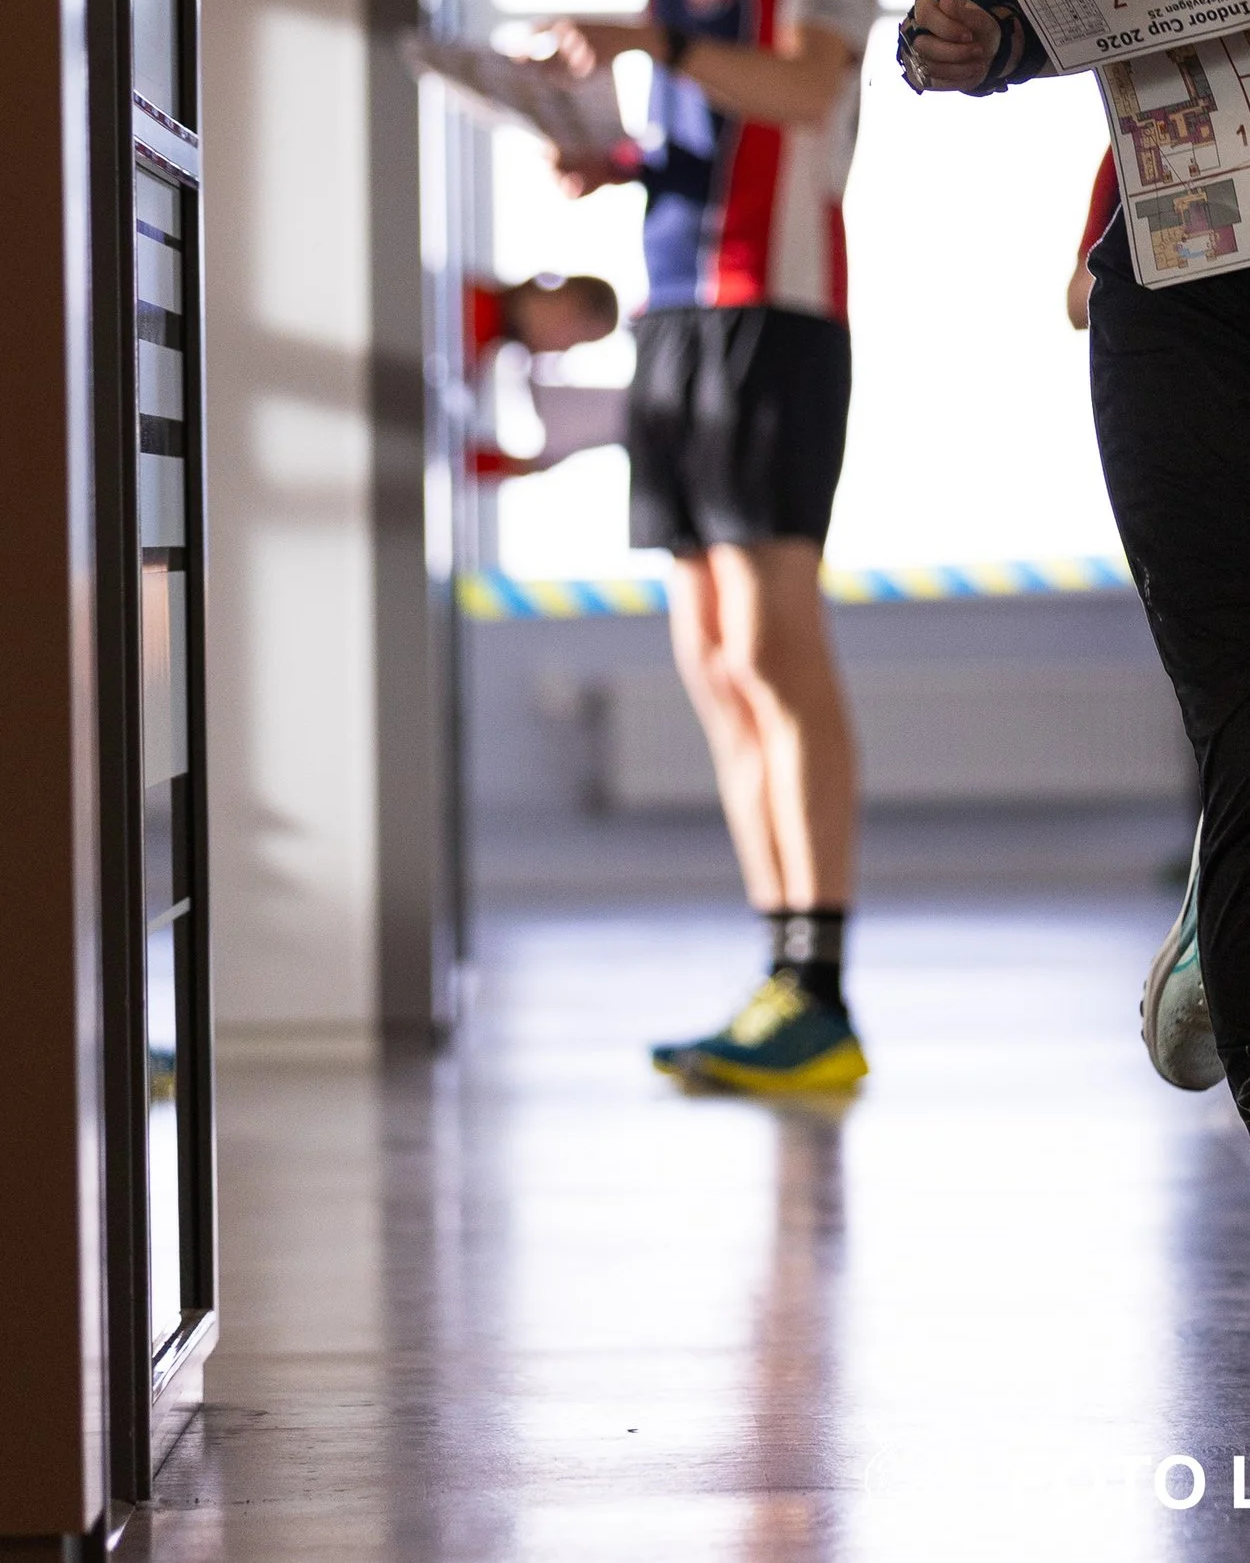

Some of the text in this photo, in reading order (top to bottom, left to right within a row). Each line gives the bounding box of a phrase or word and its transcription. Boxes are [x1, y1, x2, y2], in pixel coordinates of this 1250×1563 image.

[1147, 8, 1163, 19] 25
[1148, 21, 1184, 37] Cup
[1097, 32, 1144, 53] 2026
[1236, 124, 1248, 147] 1
